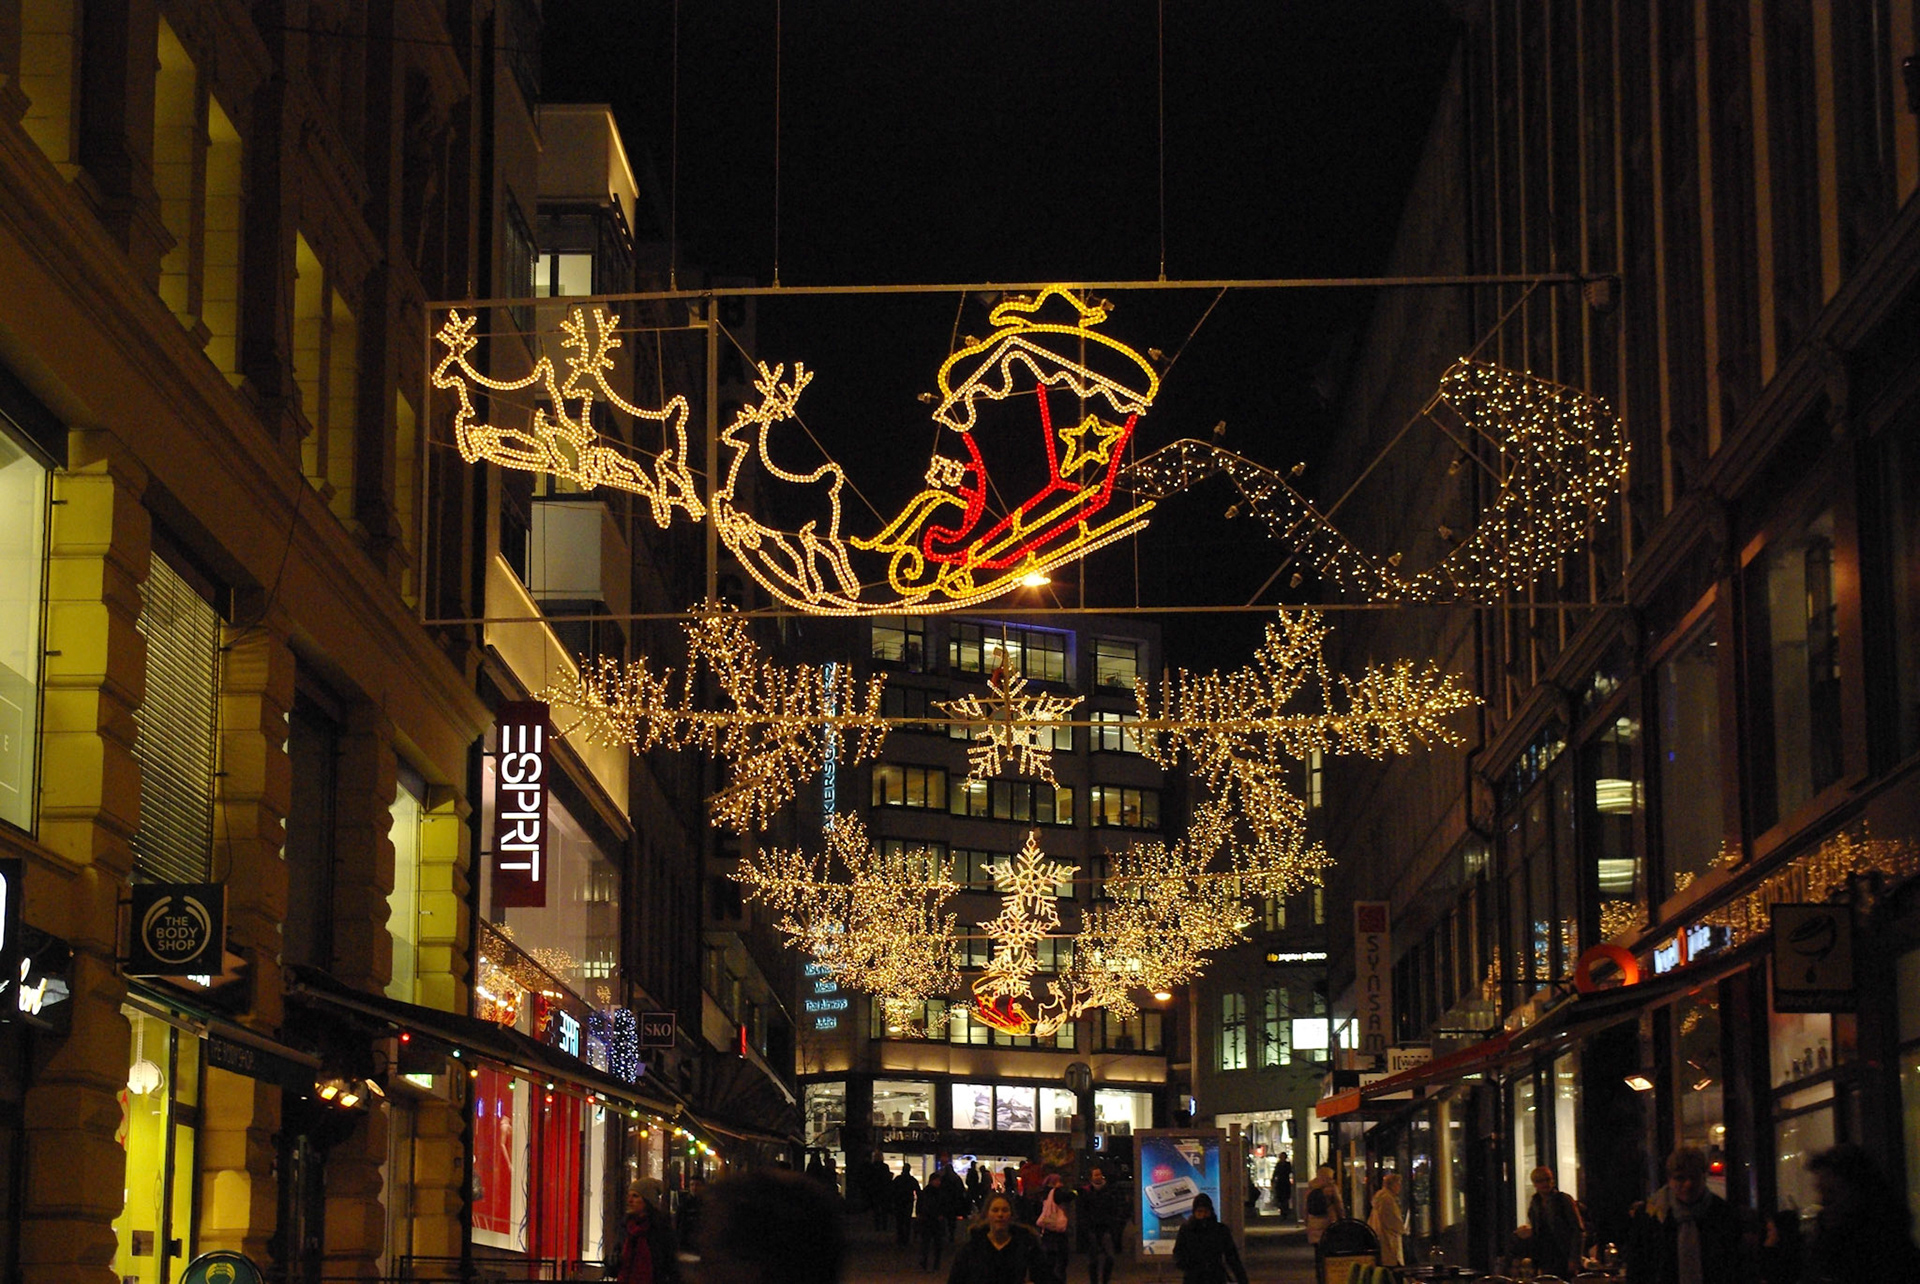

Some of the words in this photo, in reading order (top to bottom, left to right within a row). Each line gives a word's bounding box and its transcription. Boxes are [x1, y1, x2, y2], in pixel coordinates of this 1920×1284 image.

[500, 725, 543, 882] ESPRIT
[165, 916, 188, 927] THE
[156, 927, 199, 939] BODY
[158, 940, 196, 951] SHOP
[644, 1023, 672, 1037] SKO
